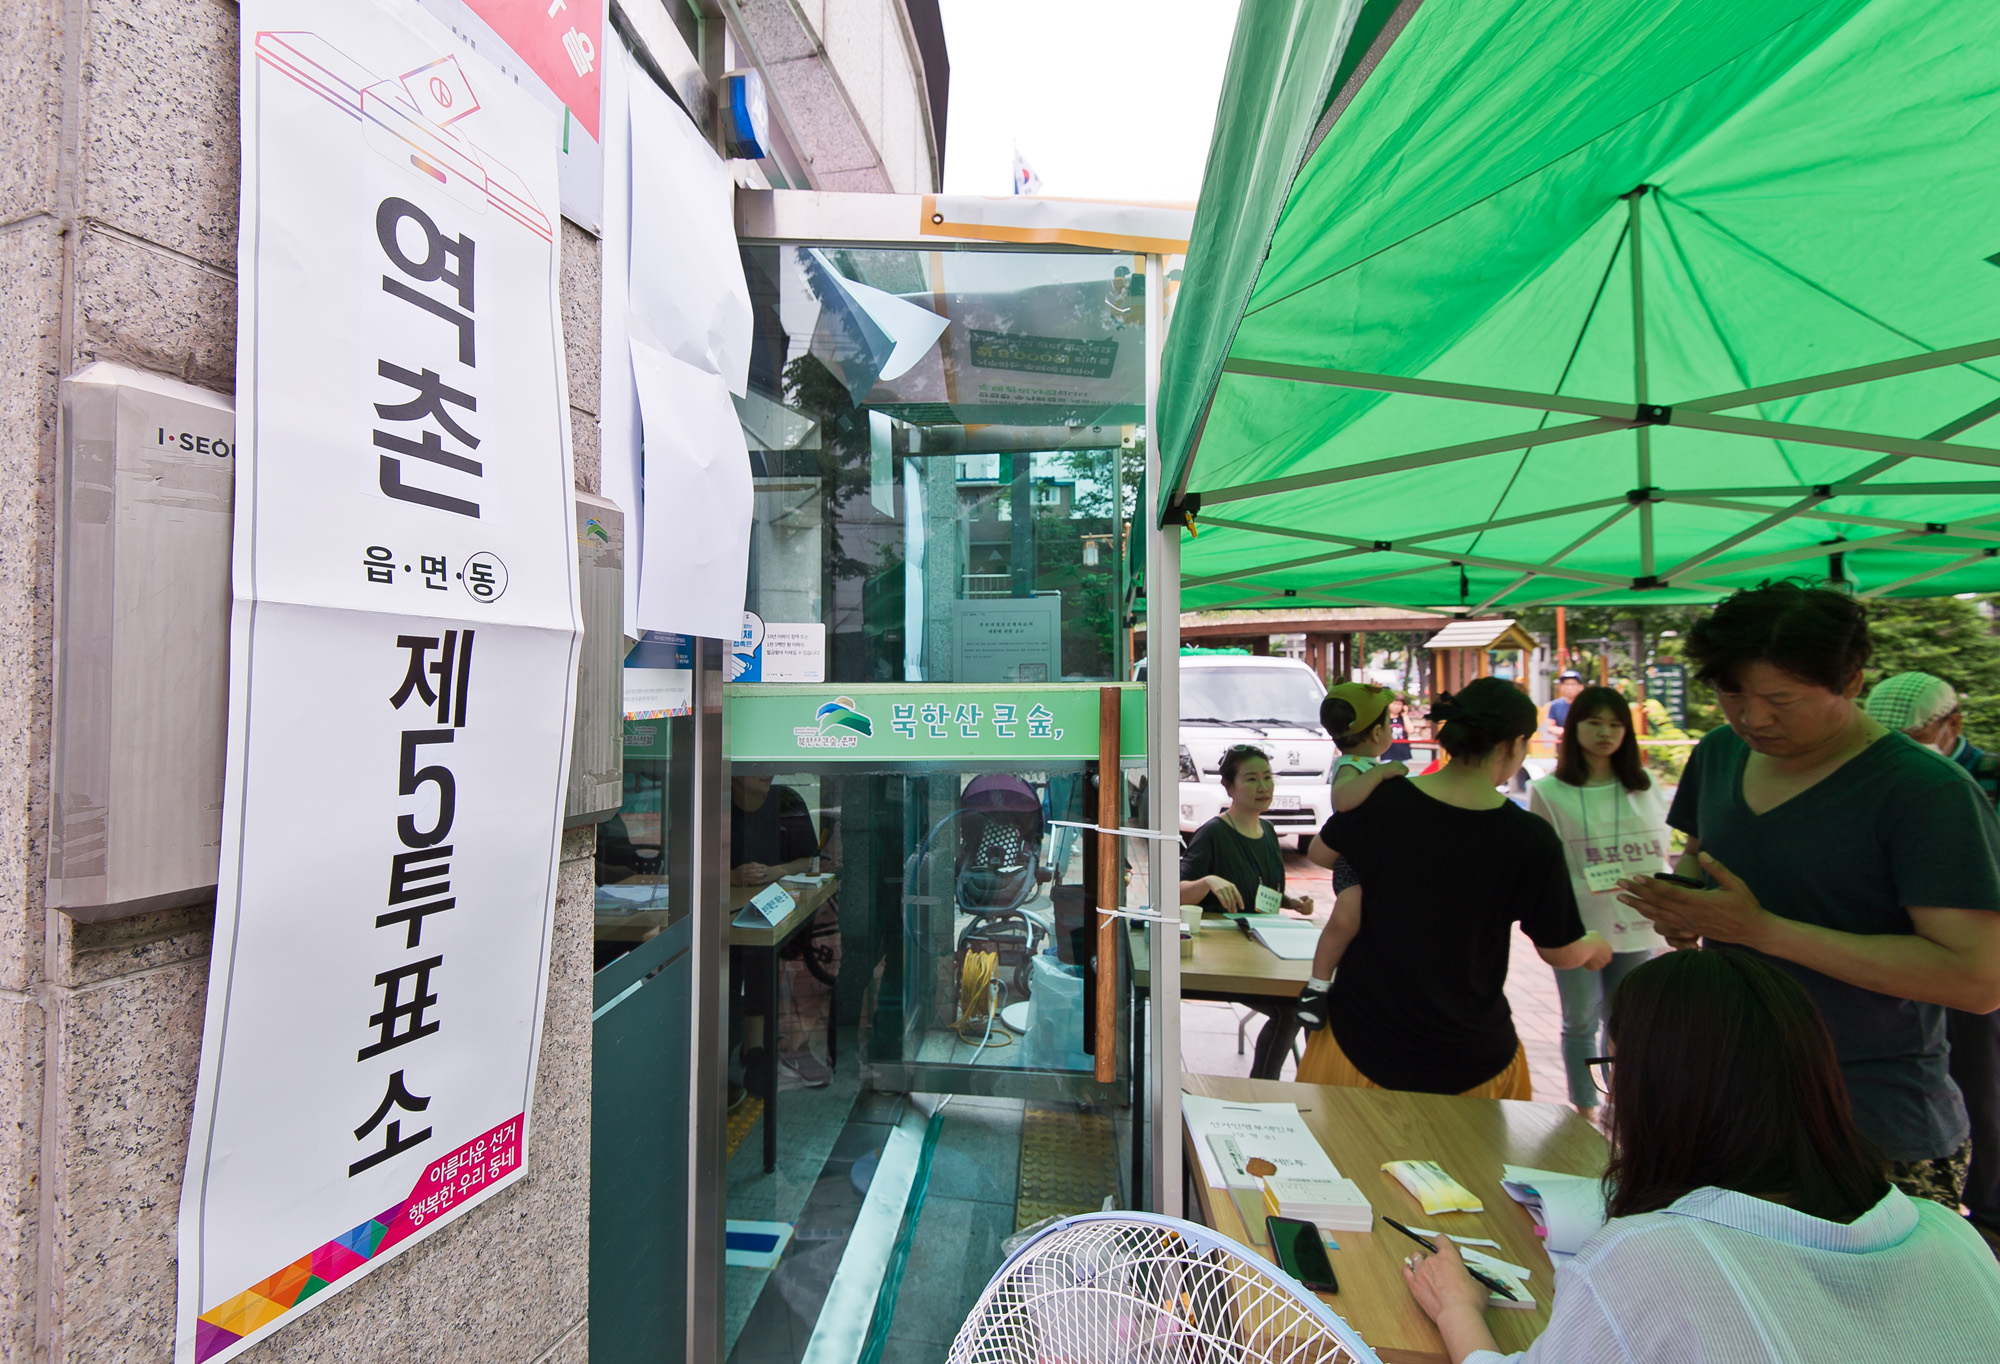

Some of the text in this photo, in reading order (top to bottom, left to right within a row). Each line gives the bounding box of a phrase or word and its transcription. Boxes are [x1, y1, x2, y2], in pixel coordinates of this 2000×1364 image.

[374, 197, 485, 519] 역촌
[891, 703, 983, 739] 북한산
[992, 703, 1018, 738] 큰
[1585, 840, 1663, 864] 투표안내
[348, 630, 475, 1179] 제5투표소
[409, 1146, 515, 1226] 행복한 우리 동네
[430, 1122, 516, 1183] 아름다운 선거
